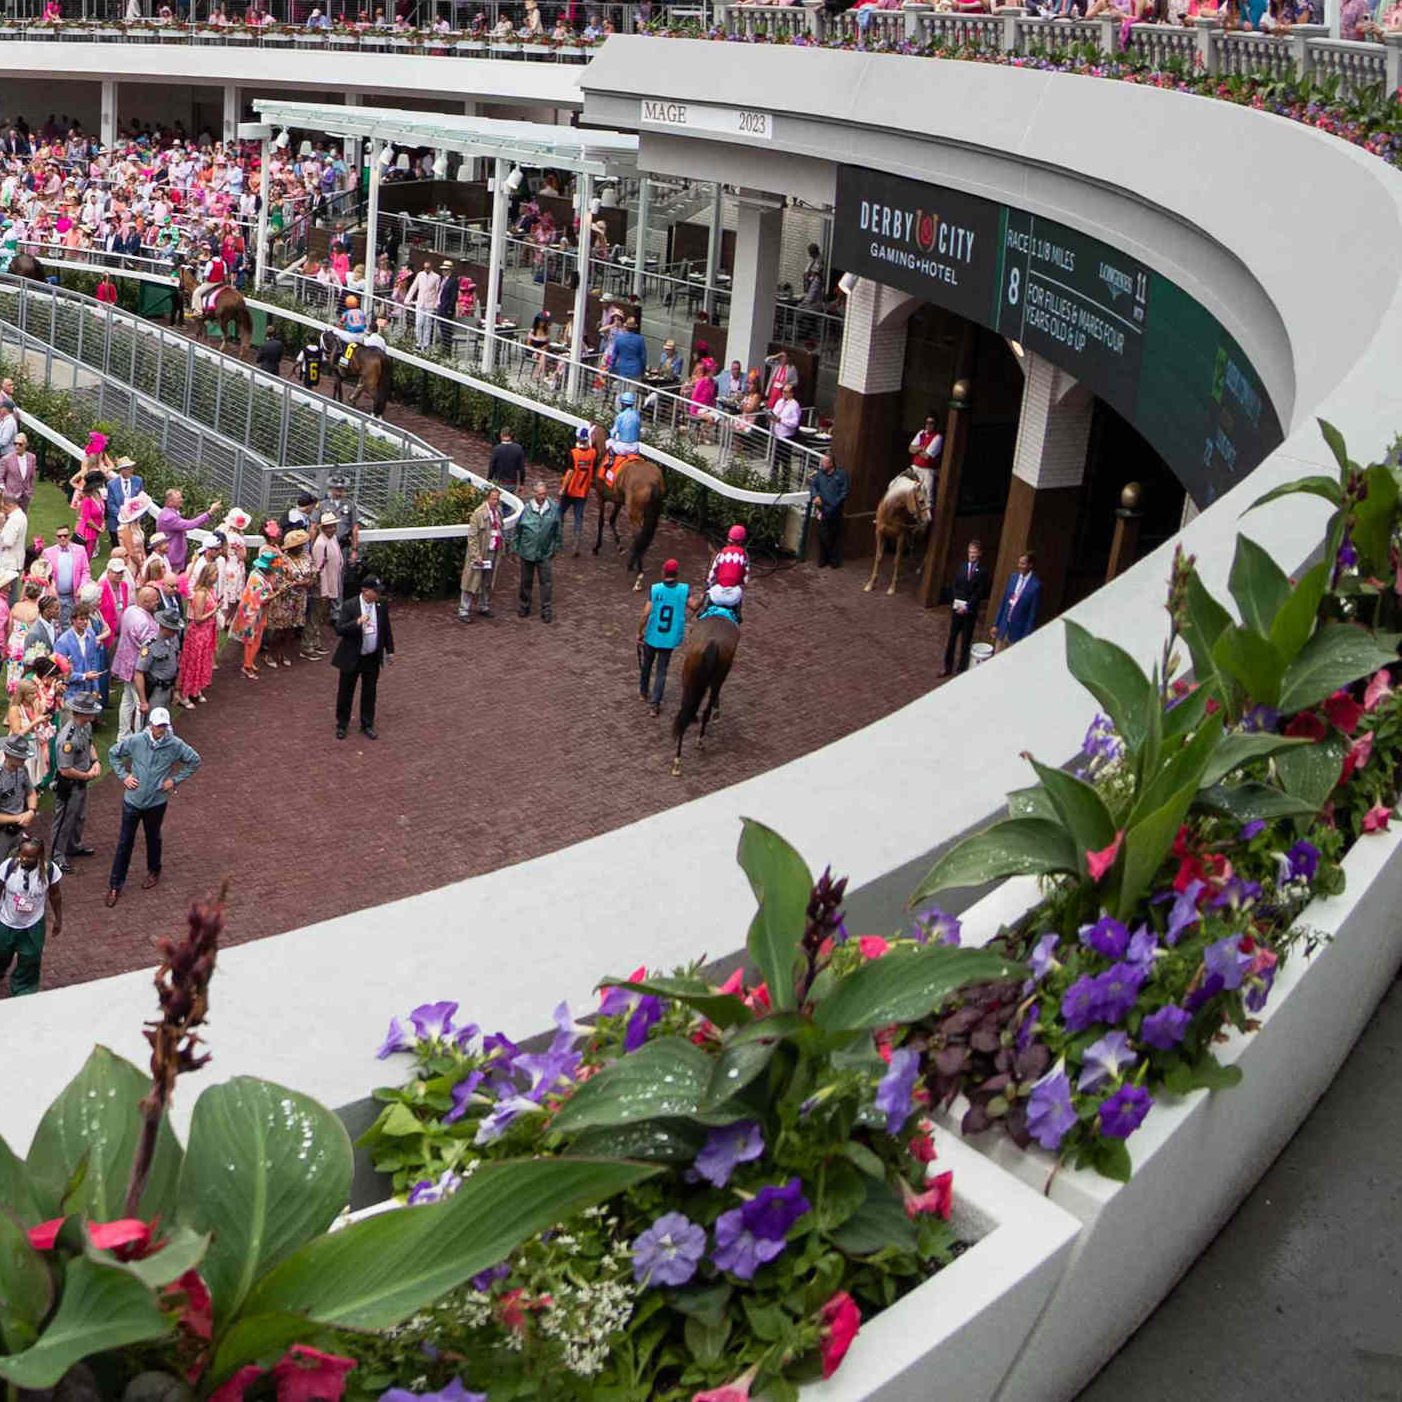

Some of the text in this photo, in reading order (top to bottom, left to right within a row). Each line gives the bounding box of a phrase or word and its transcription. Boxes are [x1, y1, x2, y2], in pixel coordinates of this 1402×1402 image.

[644, 101, 687, 123] MAGE
[739, 111, 766, 133] 2023
[860, 201, 974, 263] DERBY CITY
[1006, 229, 1029, 254] RACE
[1051, 245, 1076, 271] MILES
[1008, 267, 1020, 305] 8
[1135, 272, 1147, 304] 11
[1025, 305, 1050, 332] YEARS
[1050, 318, 1067, 341] OLD
[1074, 330, 1086, 352] UP
[1027, 283, 1044, 305] FOR
[1044, 291, 1071, 321] FILLIES
[1078, 308, 1103, 341] MARES
[1103, 324, 1125, 355] FOUR
[345, 342, 358, 359] 6
[309, 363, 318, 381] 6
[579, 468, 589, 488] 7
[657, 605, 674, 633] 9
